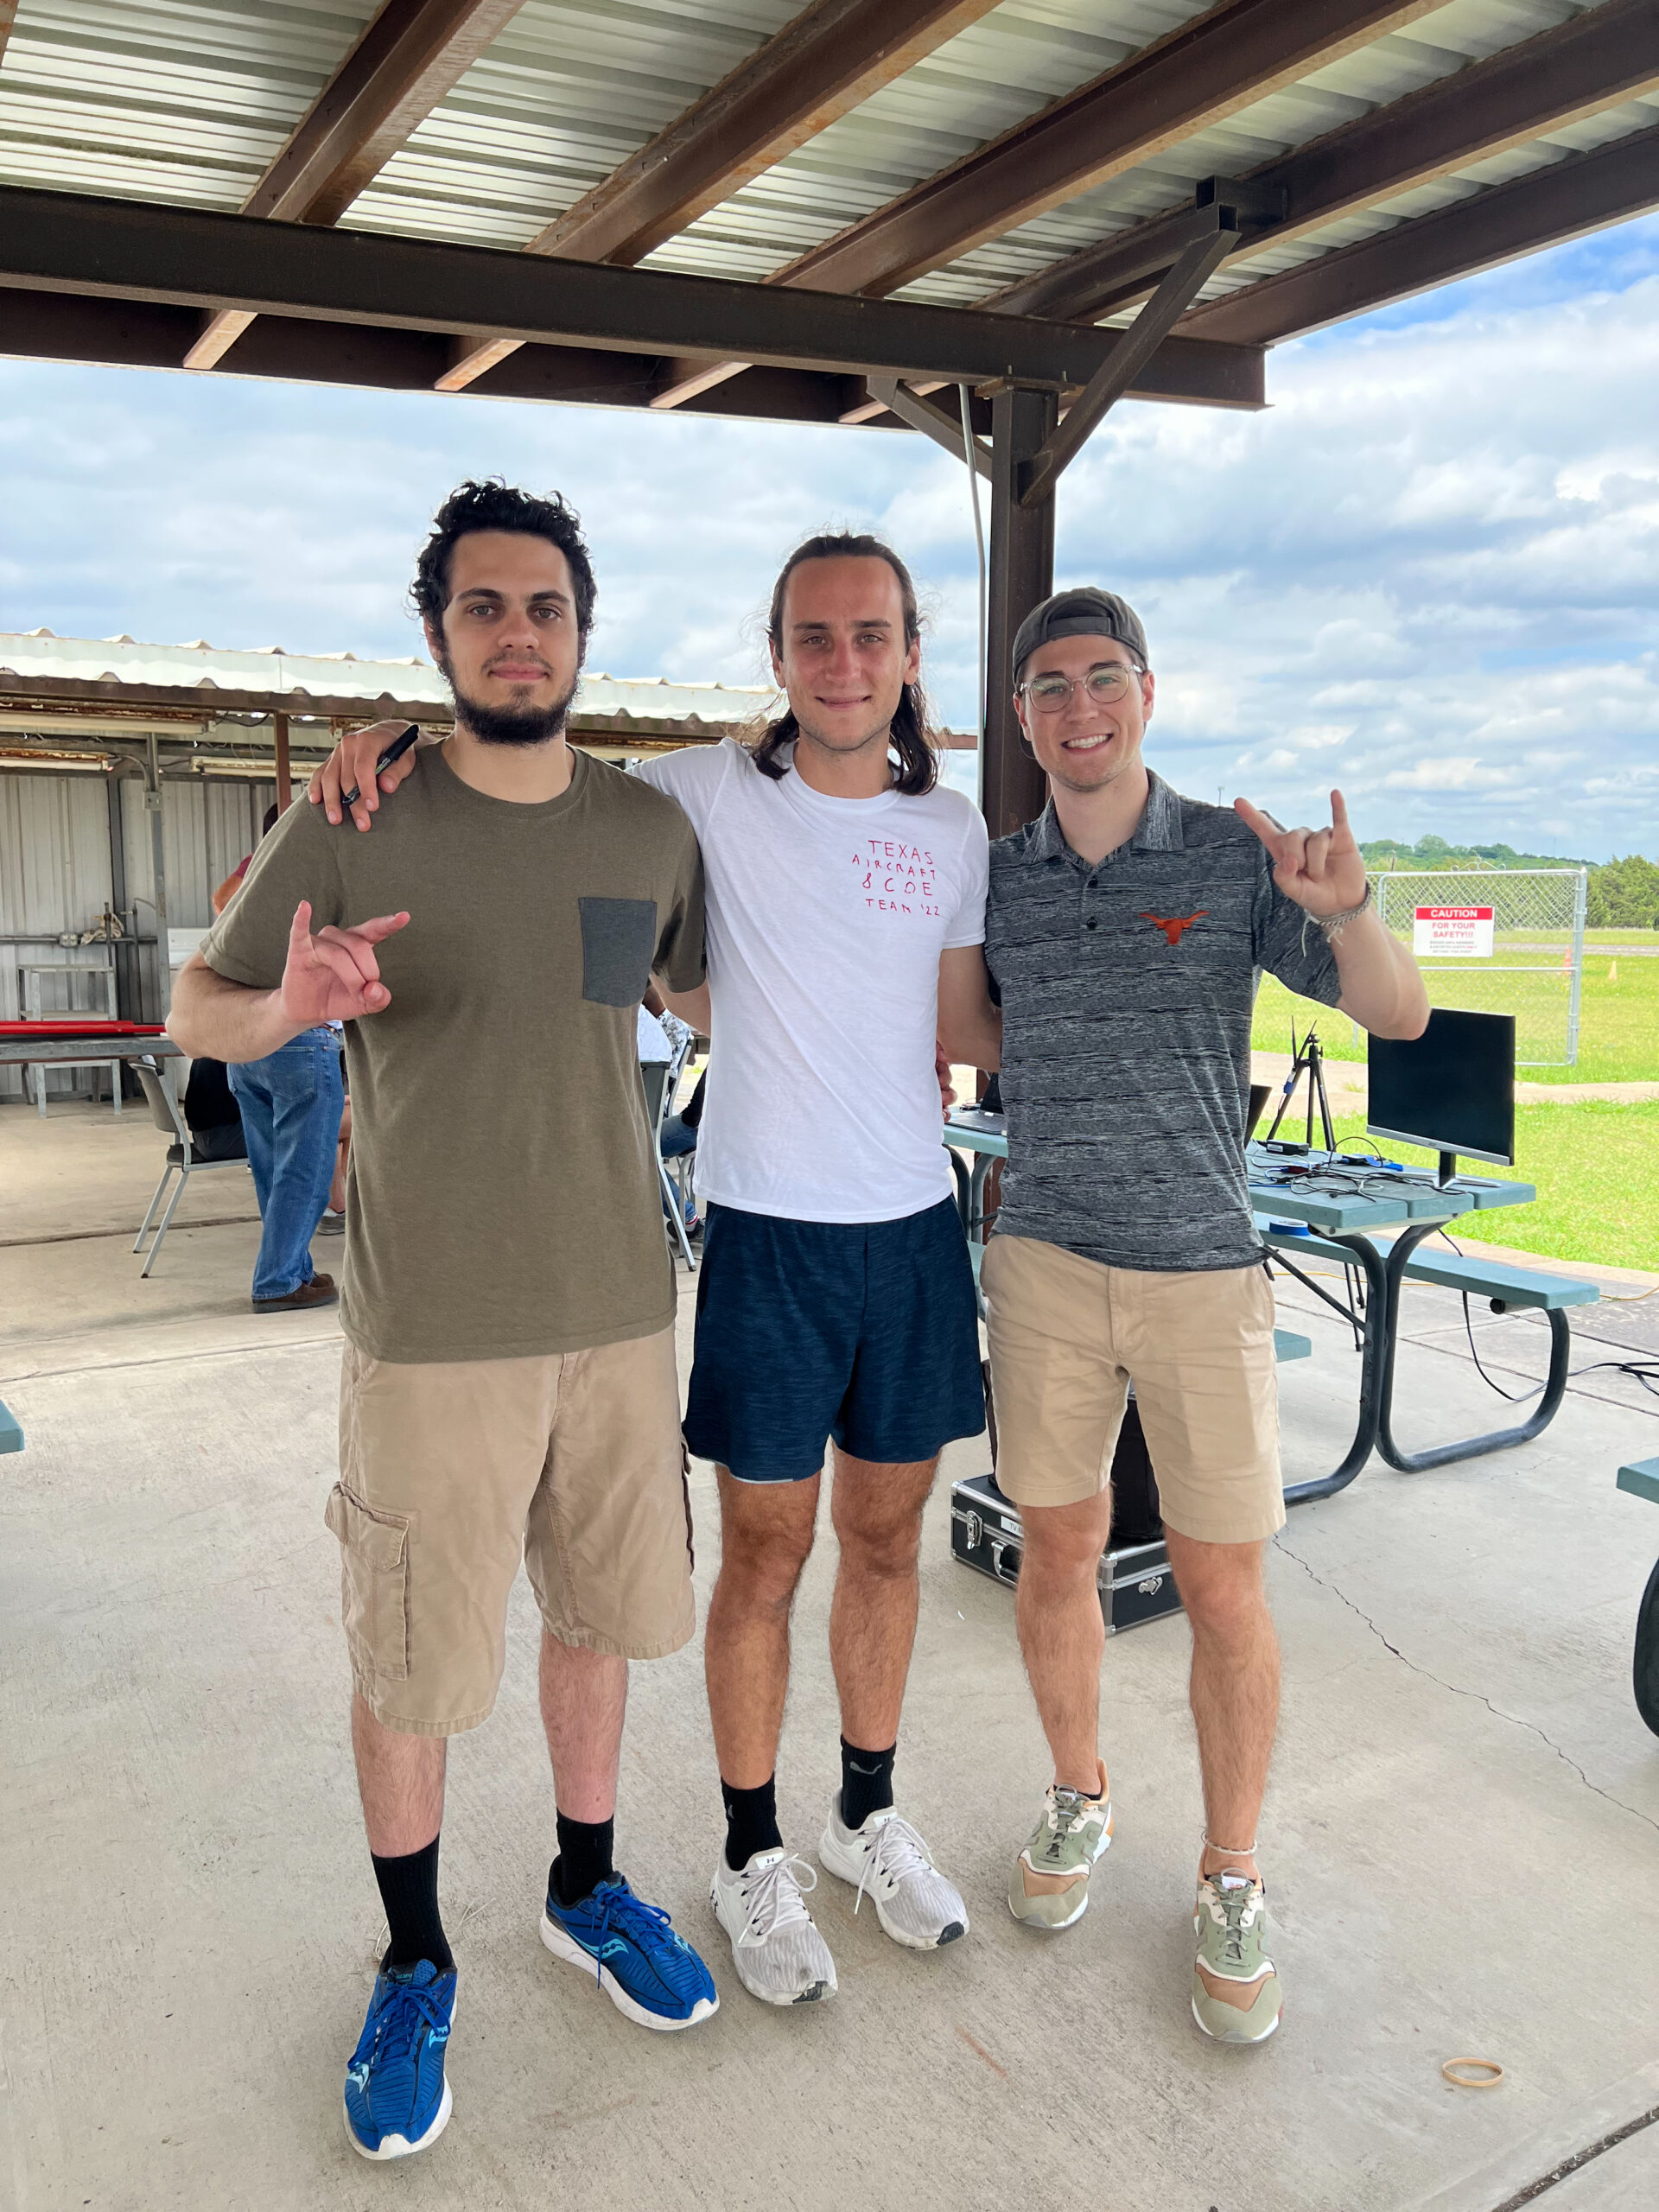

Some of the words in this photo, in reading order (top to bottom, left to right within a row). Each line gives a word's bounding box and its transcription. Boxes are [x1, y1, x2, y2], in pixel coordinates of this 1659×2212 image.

[868, 840, 933, 865] TEXAS
[852, 854, 935, 880] AIRCRAFT
[1431, 909, 1478, 918] CAUTION
